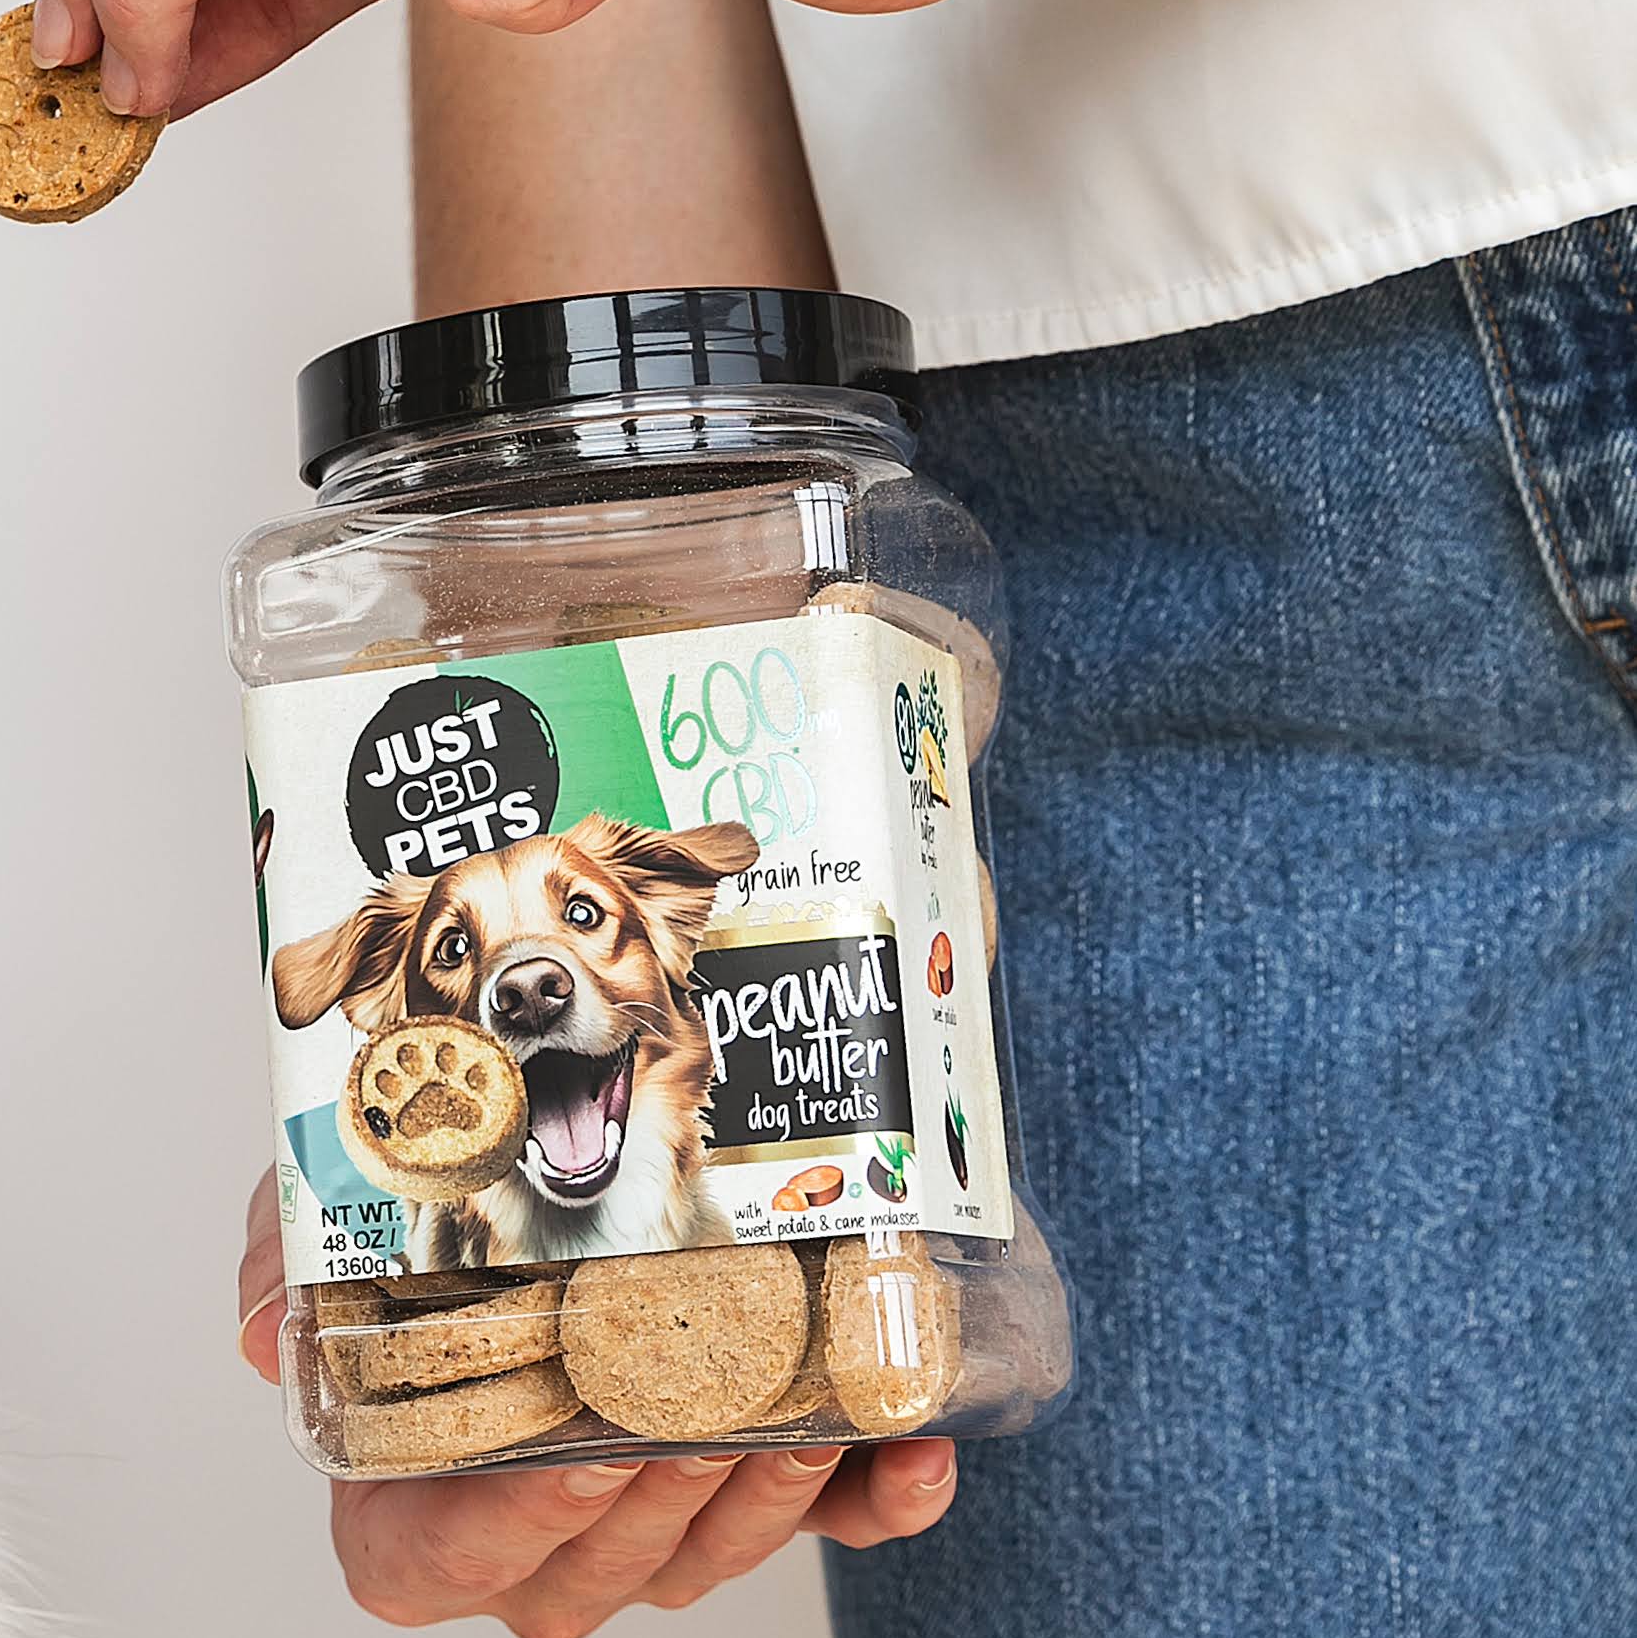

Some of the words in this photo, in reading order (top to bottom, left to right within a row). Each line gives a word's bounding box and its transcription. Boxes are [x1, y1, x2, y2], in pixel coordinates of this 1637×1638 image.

[659, 647, 806, 771] 600
[364, 698, 502, 788] JUST
[395, 758, 499, 823] CBD
[383, 790, 541, 875] PETS
[737, 861, 801, 907] grain
[810, 849, 862, 886] free
[701, 932, 898, 1085] peanut
[768, 1015, 890, 1094] butter
[747, 1091, 792, 1142] dog
[794, 1082, 881, 1127] treats
[321, 1204, 353, 1228] NT
[358, 1200, 402, 1225] WT.
[322, 1233, 348, 1253] 48
[353, 1228, 386, 1250] OZ
[390, 1227, 397, 1248] /
[734, 1201, 763, 1220] with
[735, 1218, 773, 1240] sweet
[777, 1216, 816, 1242] potato
[819, 1214, 832, 1232] &
[834, 1214, 866, 1231] cane
[870, 1207, 921, 1227] molasses
[325, 1255, 388, 1278] 1360g
